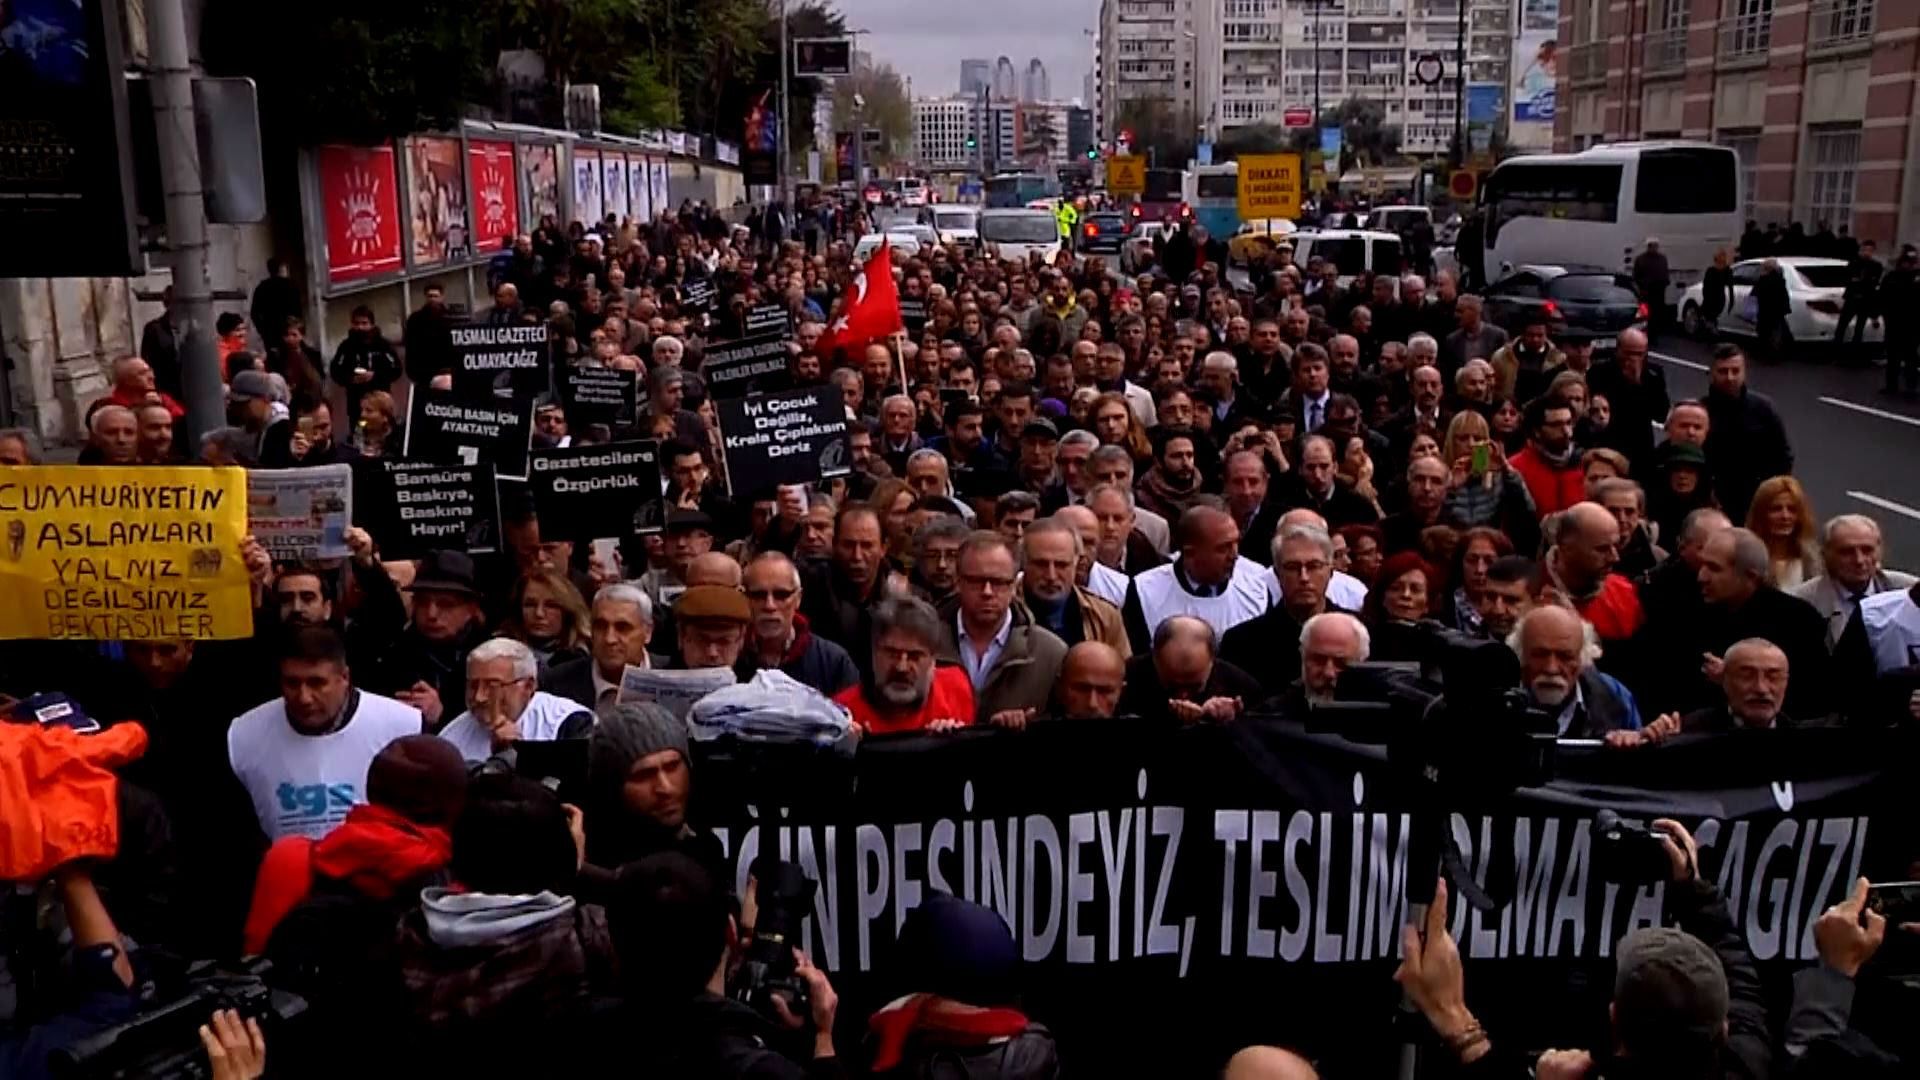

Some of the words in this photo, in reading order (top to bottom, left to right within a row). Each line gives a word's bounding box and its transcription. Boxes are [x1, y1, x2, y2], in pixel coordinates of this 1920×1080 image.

[450, 329, 496, 345] TASMALI
[497, 323, 547, 344] GAZETECİ
[463, 348, 539, 370] OLMAYACAĞIZ
[767, 394, 818, 414] Çocuk
[464, 408, 495, 422] BASIN
[441, 421, 499, 436] AYAKTAYIZ
[726, 432, 770, 448] Krala
[767, 441, 811, 458] Deriz
[533, 451, 654, 471] Gazetecilere
[553, 473, 639, 493] Özgürlük
[37, 520, 214, 551] ASLANLARI
[410, 520, 466, 537] Hayır!
[51, 556, 182, 586] YALNIZ
[276, 782, 354, 816] tgs
[1215, 772, 1411, 962] TESLİM
